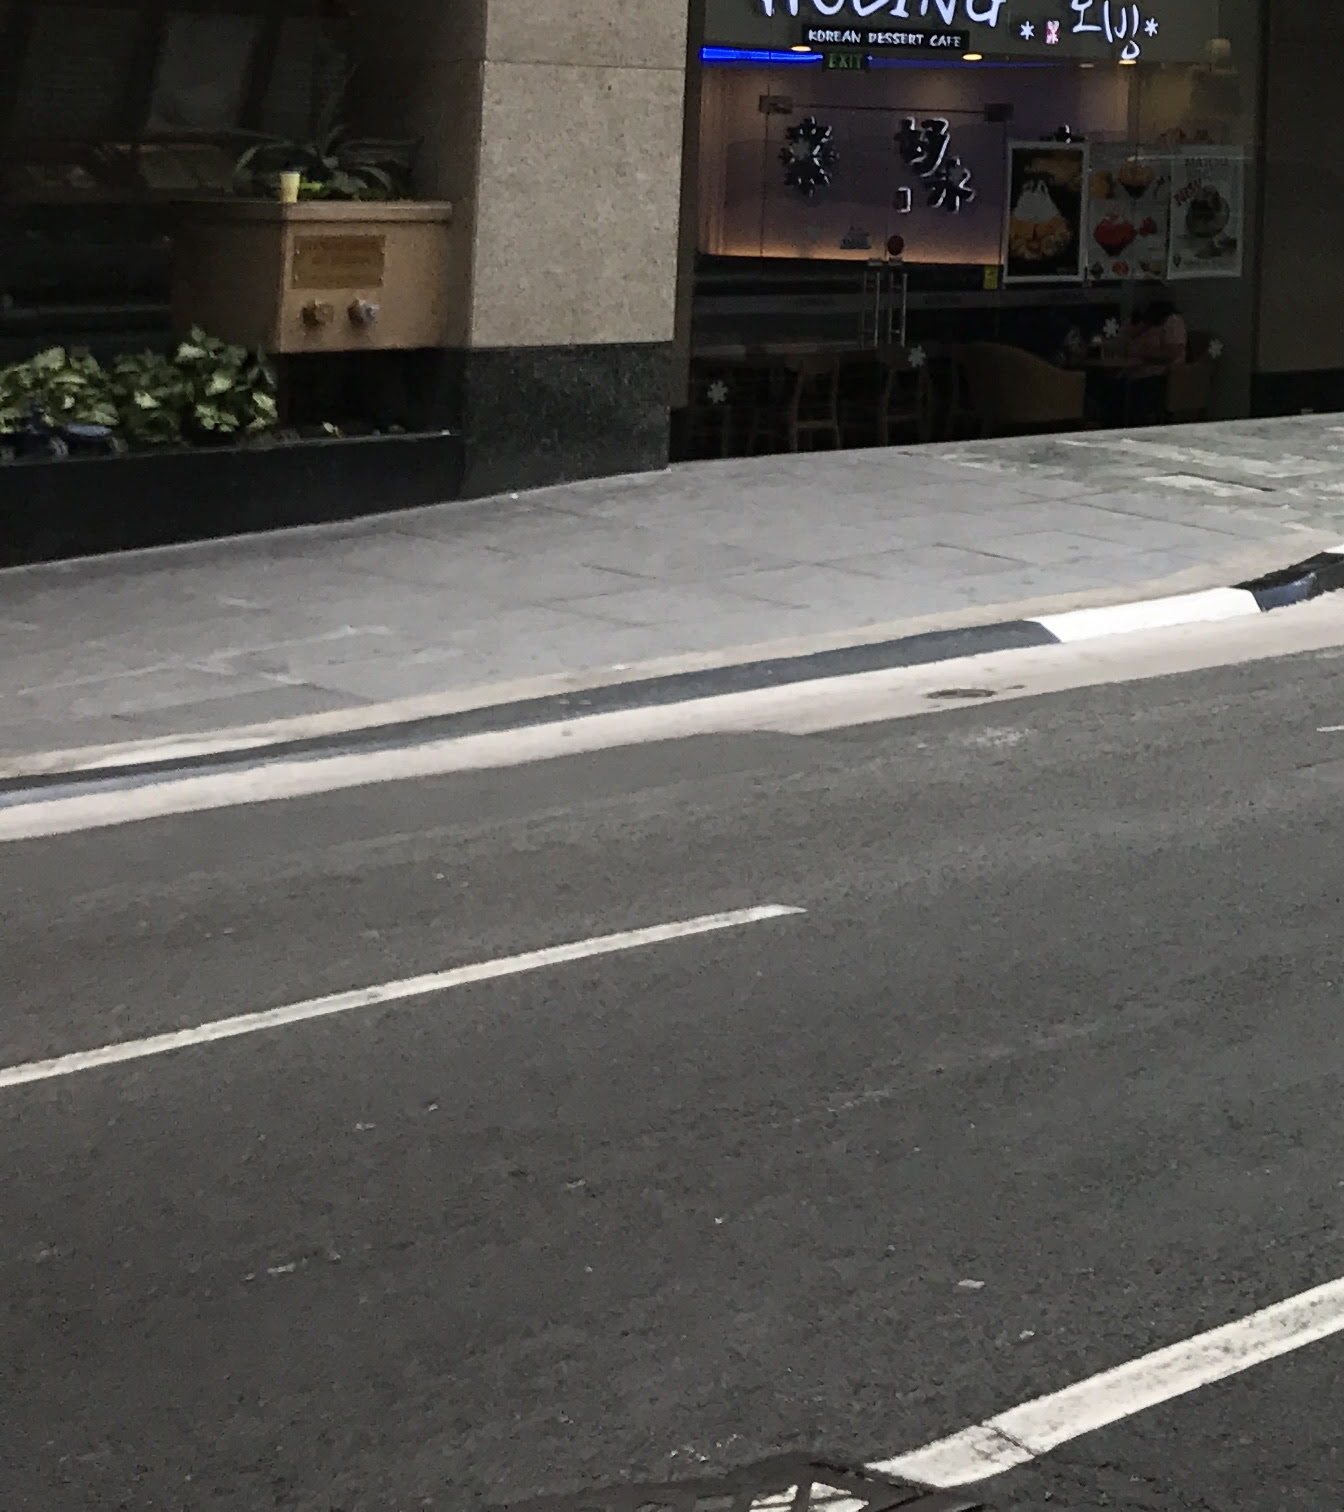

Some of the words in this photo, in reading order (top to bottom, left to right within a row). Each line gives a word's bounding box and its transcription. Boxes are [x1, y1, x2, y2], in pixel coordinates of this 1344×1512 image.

[808, 30, 861, 44] KOREAN
[868, 32, 924, 47] DESSERT
[930, 34, 961, 48] CAFE
[828, 52, 862, 70] EXIT
